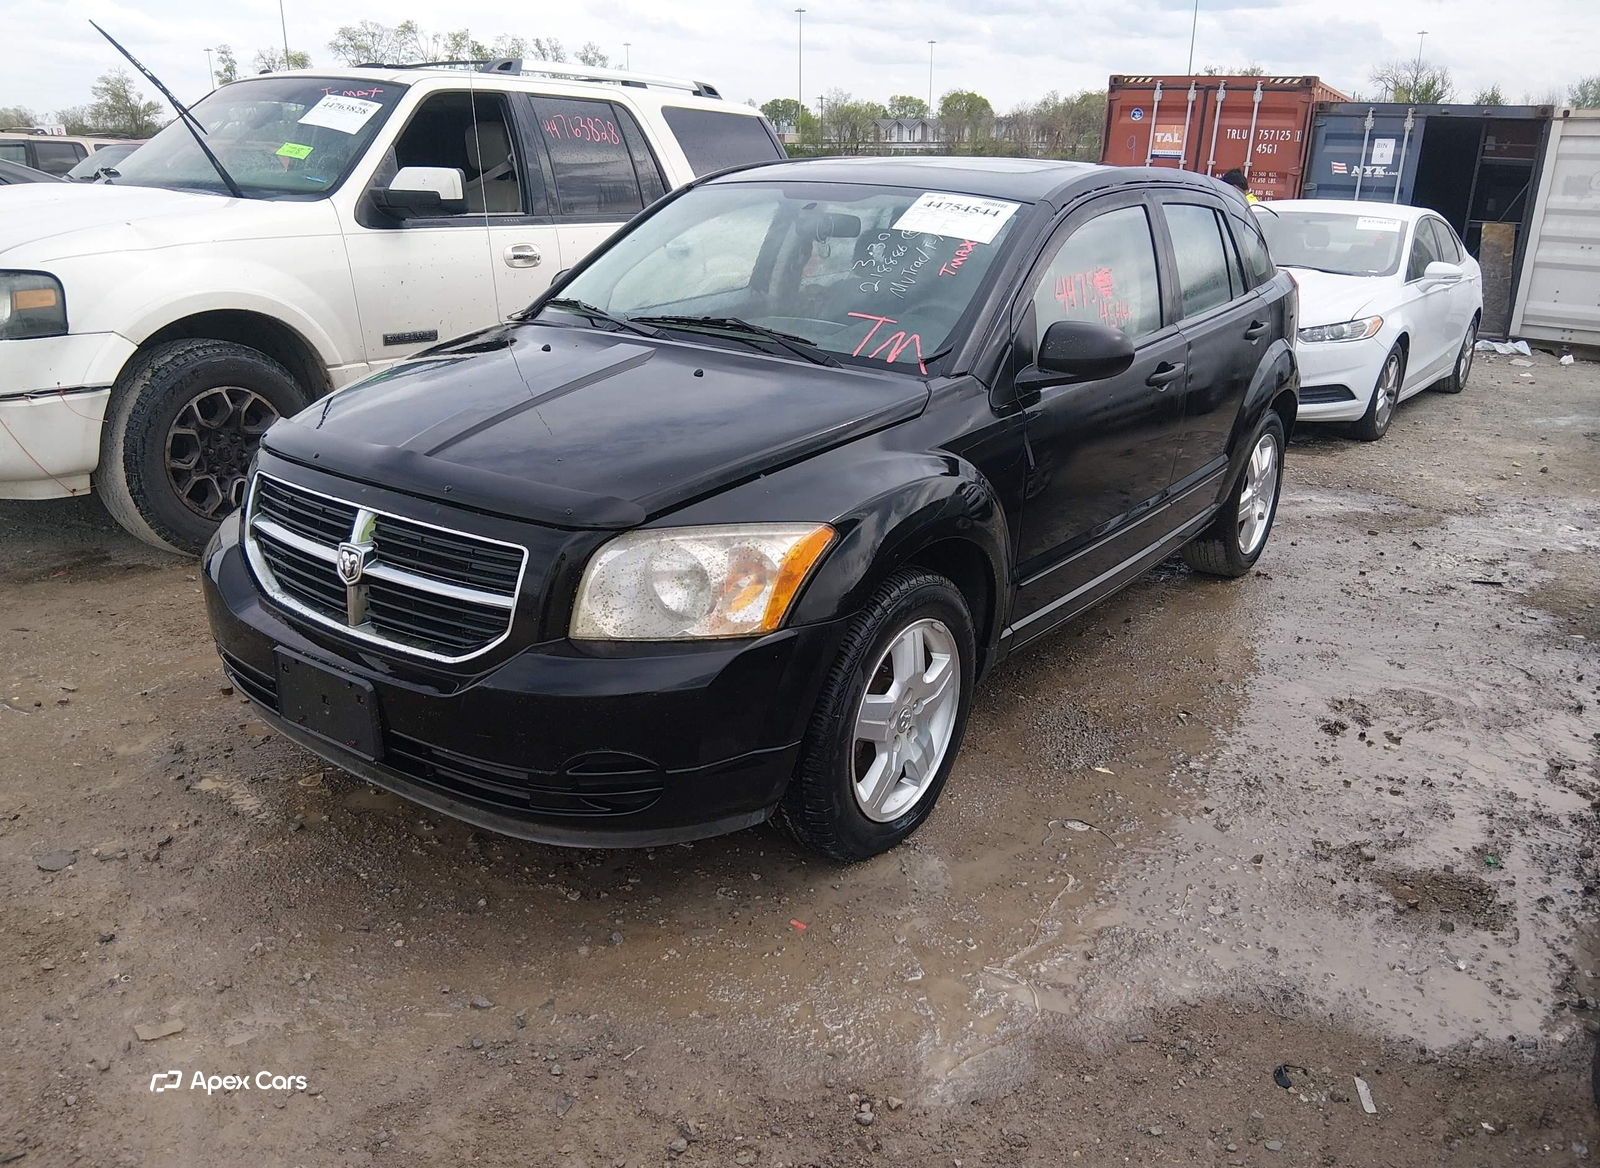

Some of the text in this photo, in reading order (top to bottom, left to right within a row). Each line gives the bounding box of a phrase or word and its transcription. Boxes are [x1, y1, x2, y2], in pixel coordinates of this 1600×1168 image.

[323, 101, 369, 115] 44763828
[543, 114, 620, 145] 44763828
[1226, 128, 1248, 140] TRLU
[1258, 129, 1291, 141] 757125
[1154, 132, 1182, 143] TAL
[1256, 143, 1278, 154] 45G1
[1351, 165, 1387, 175] NYK
[923, 200, 1001, 217] 44754544
[848, 311, 928, 375] TM
